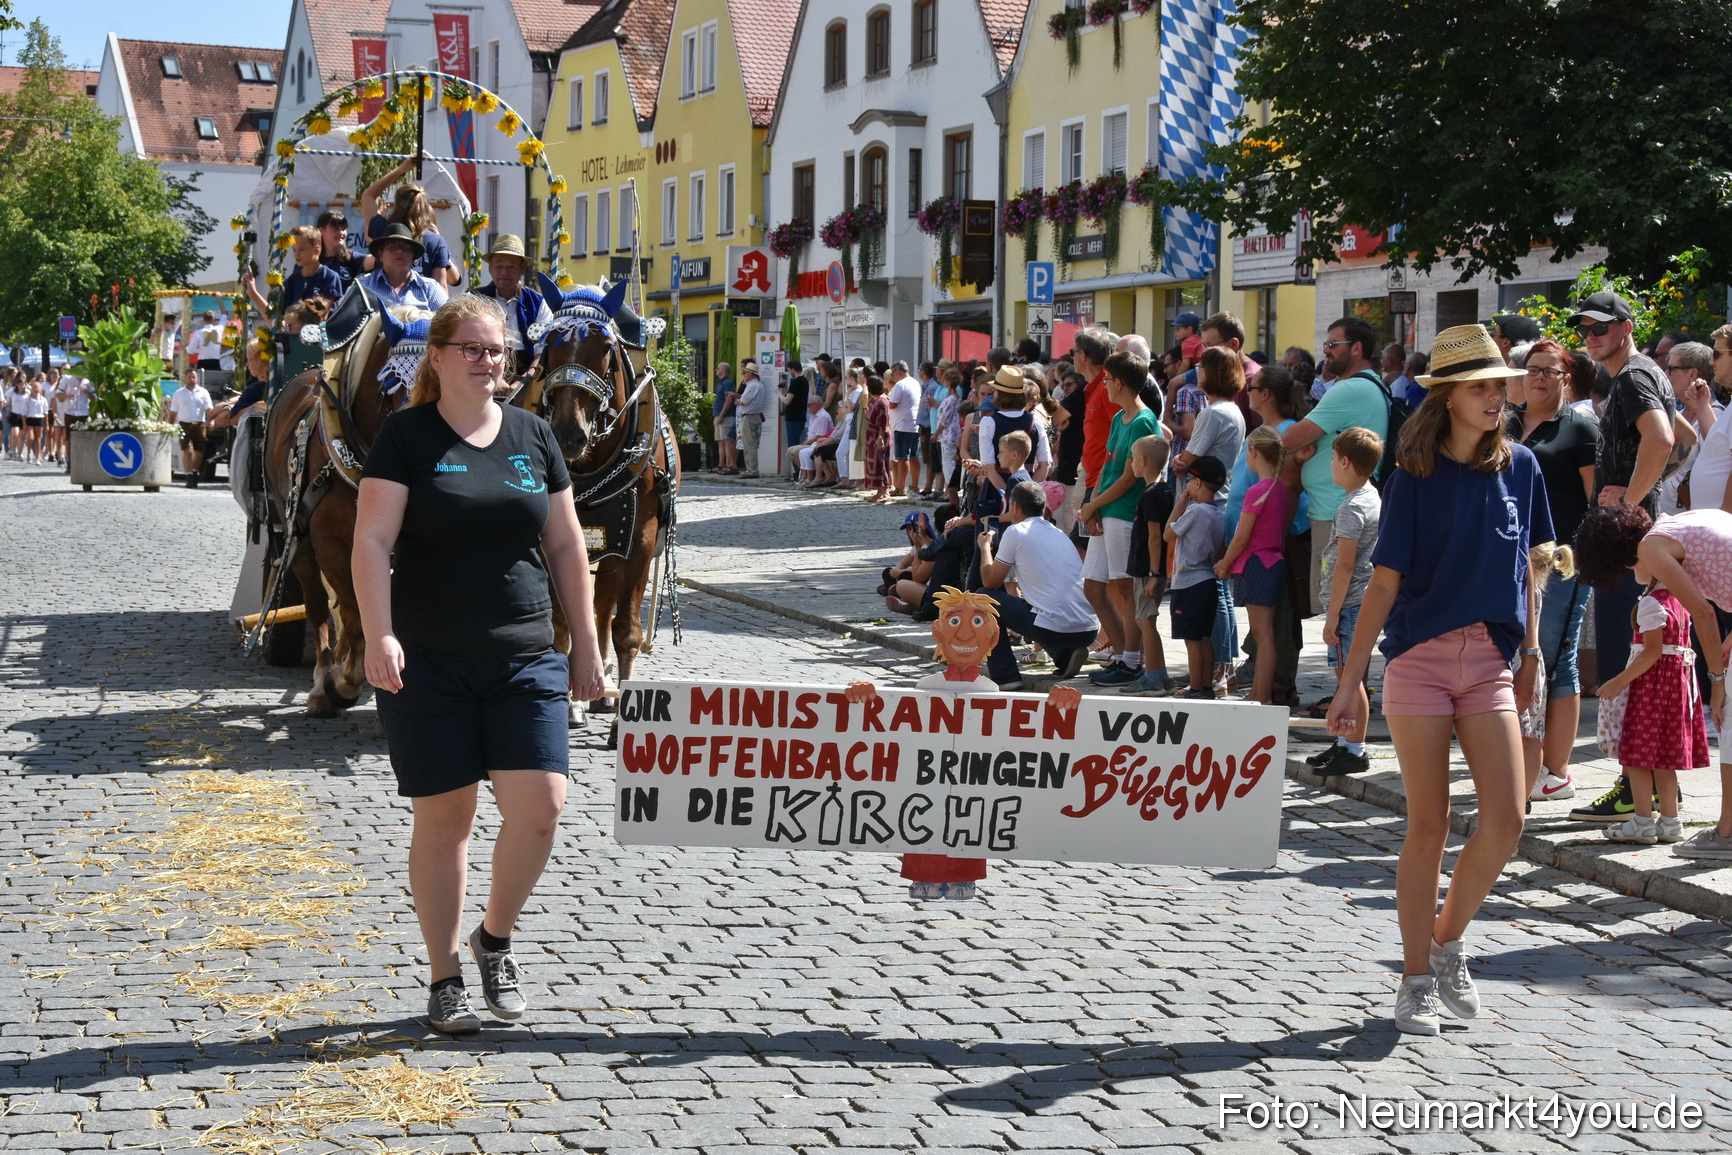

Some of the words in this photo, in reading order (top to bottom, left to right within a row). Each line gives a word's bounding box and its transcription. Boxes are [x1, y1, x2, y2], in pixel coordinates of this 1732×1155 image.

[439, 21, 460, 71] K&L
[457, 22, 466, 71] RUPPERT
[581, 156, 609, 183] HOTEL
[615, 152, 647, 175] Lehmeier
[681, 261, 704, 278] AIFUN
[1034, 267, 1048, 298] P
[434, 462, 468, 472] Johanna
[619, 688, 672, 722] WIR
[690, 686, 1079, 740] MINISTRANTEN
[1098, 710, 1189, 745] VON
[622, 732, 900, 782] WOFFENBACH
[916, 748, 1070, 789] BRINGEN
[620, 787, 659, 822] IN
[687, 787, 754, 825] DIE
[764, 782, 1022, 851] KIRCHE
